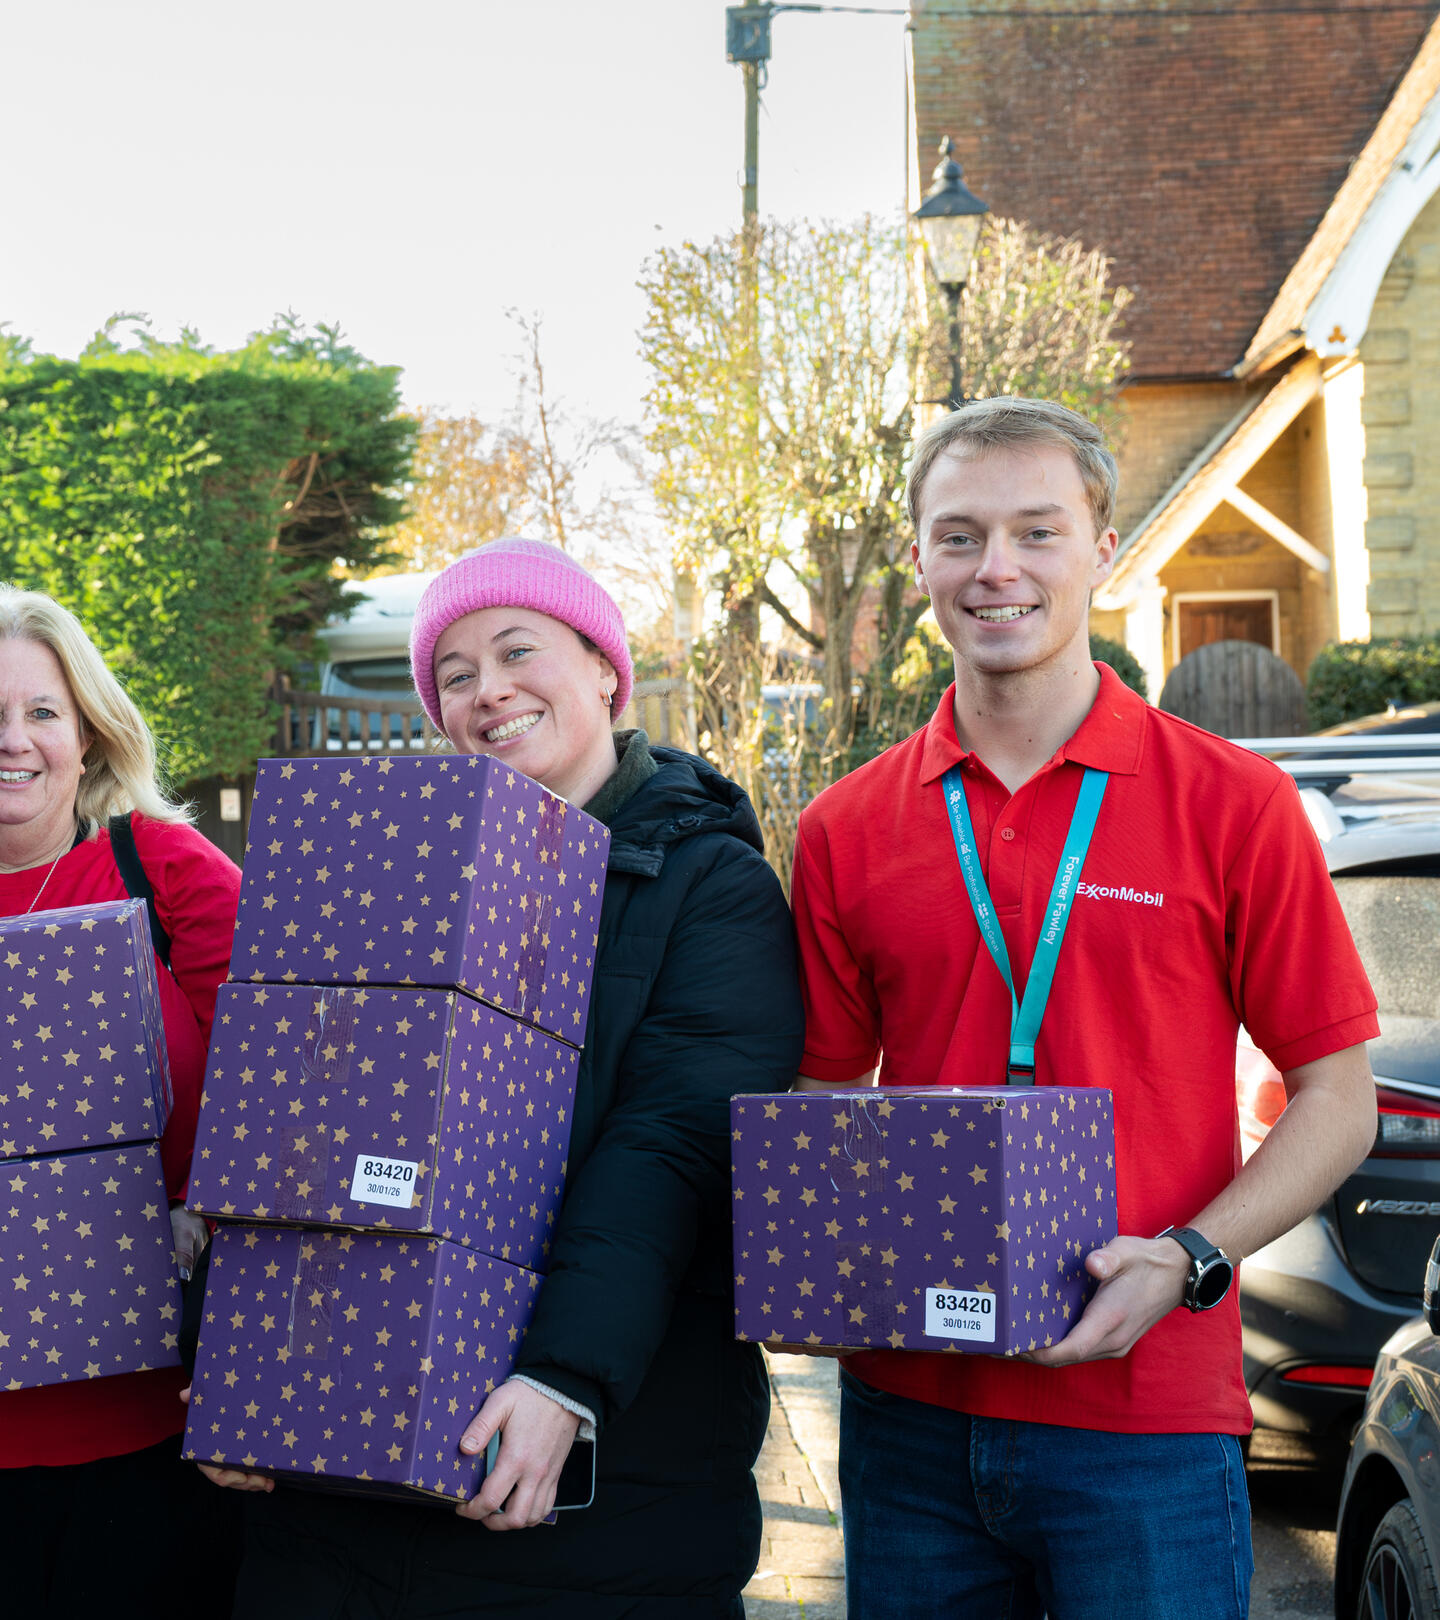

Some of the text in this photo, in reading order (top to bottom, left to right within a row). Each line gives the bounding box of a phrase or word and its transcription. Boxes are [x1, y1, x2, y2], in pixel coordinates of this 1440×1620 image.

[1043, 856, 1079, 945] Forever Fawley
[1076, 882, 1164, 907] ExxonMobil
[363, 1161, 413, 1182] 83420
[366, 1183, 401, 1197] 30/01/26
[935, 1294, 991, 1314] 83420
[942, 1317, 981, 1331] 30/01/26
